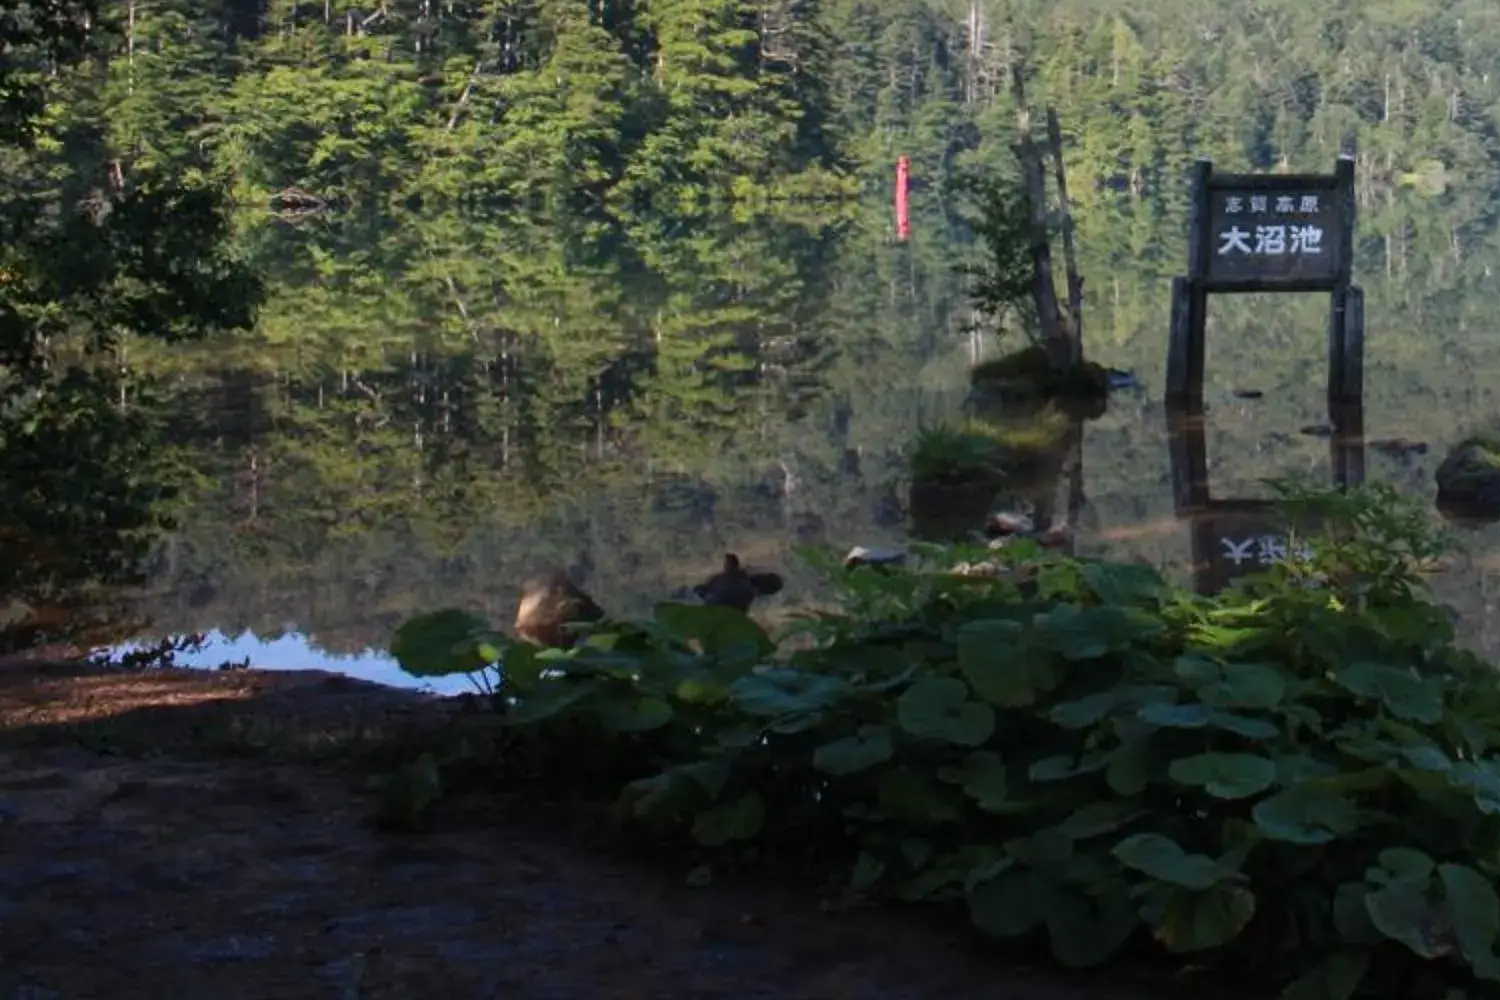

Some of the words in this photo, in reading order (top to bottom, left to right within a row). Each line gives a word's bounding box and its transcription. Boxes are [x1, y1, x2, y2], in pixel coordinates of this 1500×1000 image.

[1225, 195, 1319, 213] 志賀高原
[1218, 225, 1323, 255] 大沼池
